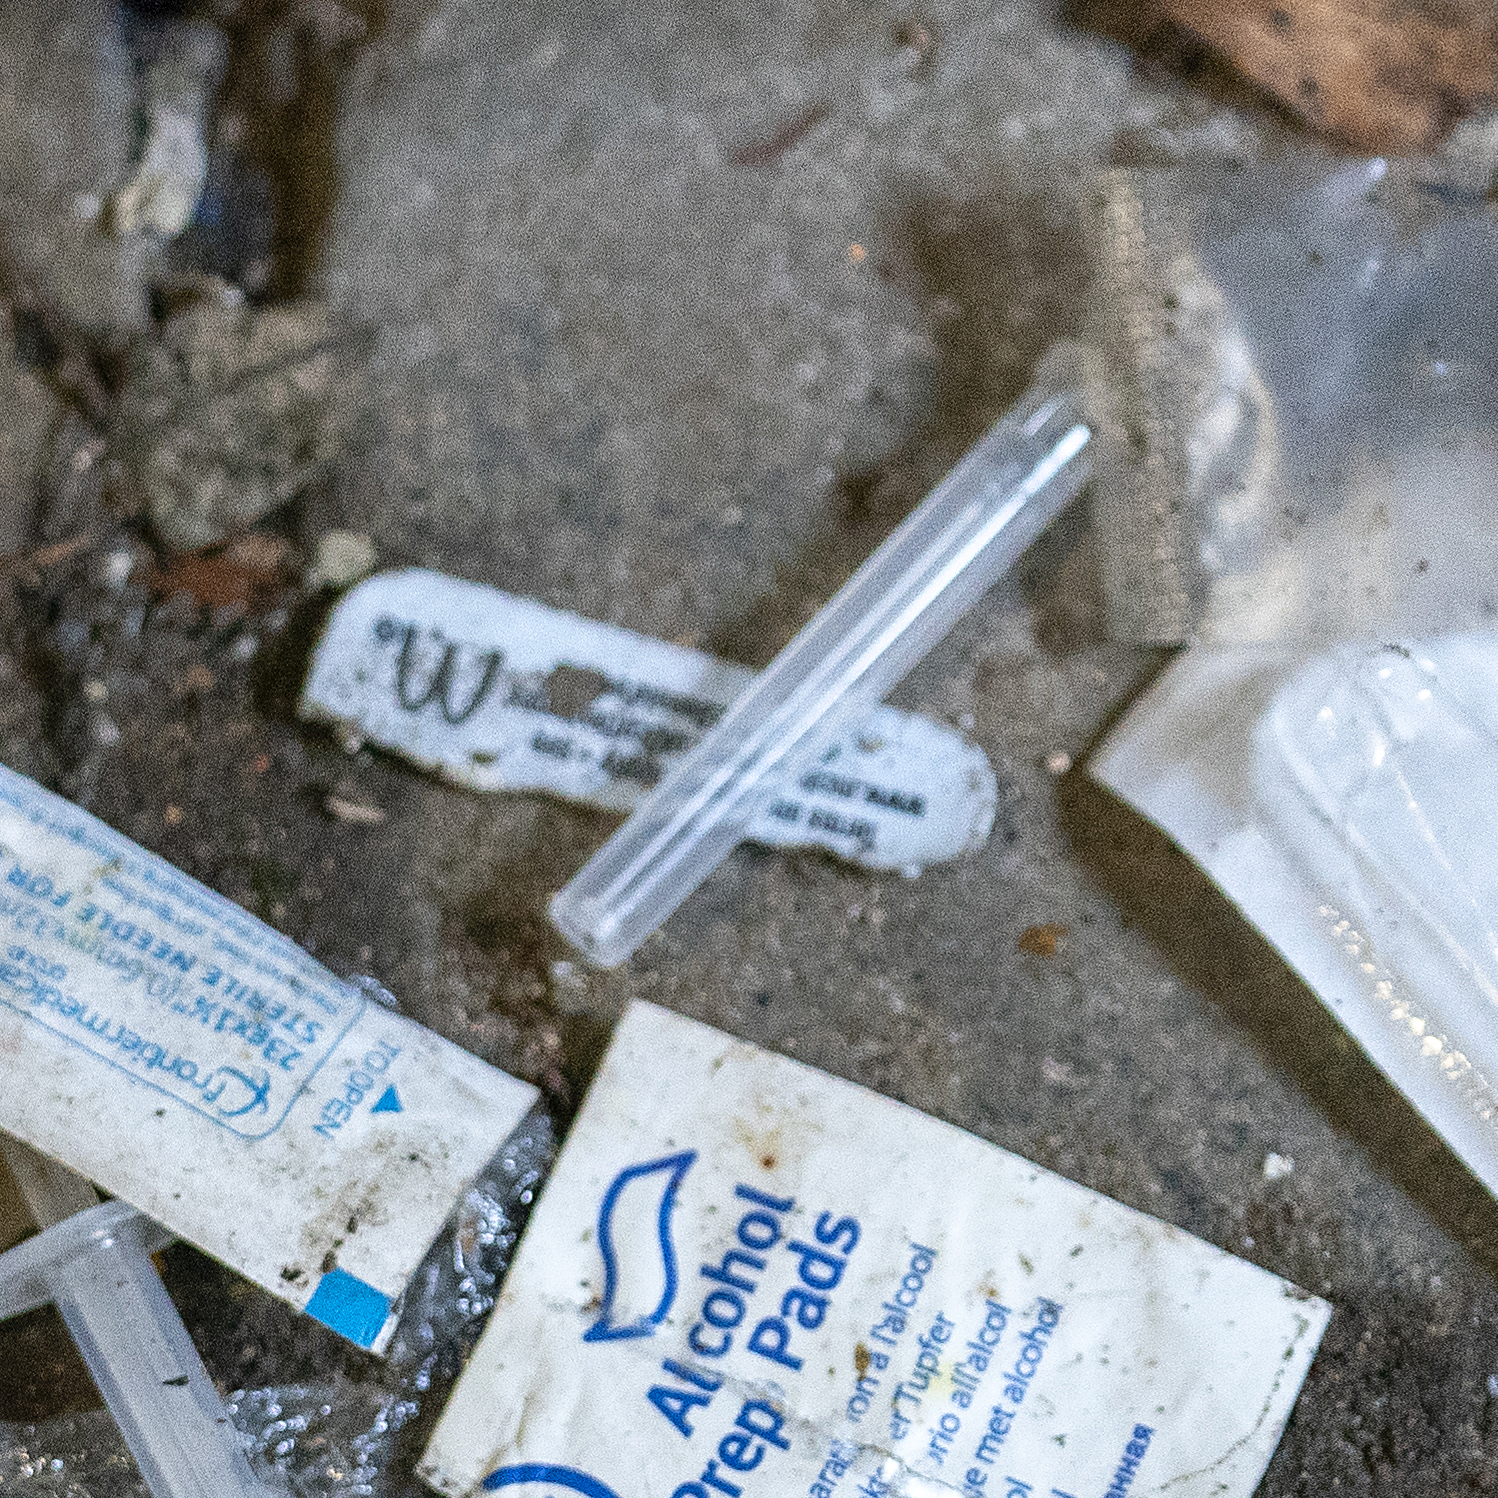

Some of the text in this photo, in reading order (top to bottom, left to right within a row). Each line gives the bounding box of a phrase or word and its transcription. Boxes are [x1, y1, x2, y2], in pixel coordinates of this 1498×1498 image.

[4, 862, 72, 907] FOR
[75, 897, 196, 972] NEEDLE
[200, 962, 324, 1044] STERILE
[311, 1039, 401, 1141] TO OPEN
[647, 1184, 796, 1439] Alcohol
[745, 1204, 866, 1373] Pads
[869, 1238, 939, 1346] l'alcool
[892, 1309, 959, 1405] Tupfer
[950, 1299, 1012, 1409] all'alcol
[975, 1402, 1017, 1464] met
[1003, 1294, 1065, 1404] alcohol
